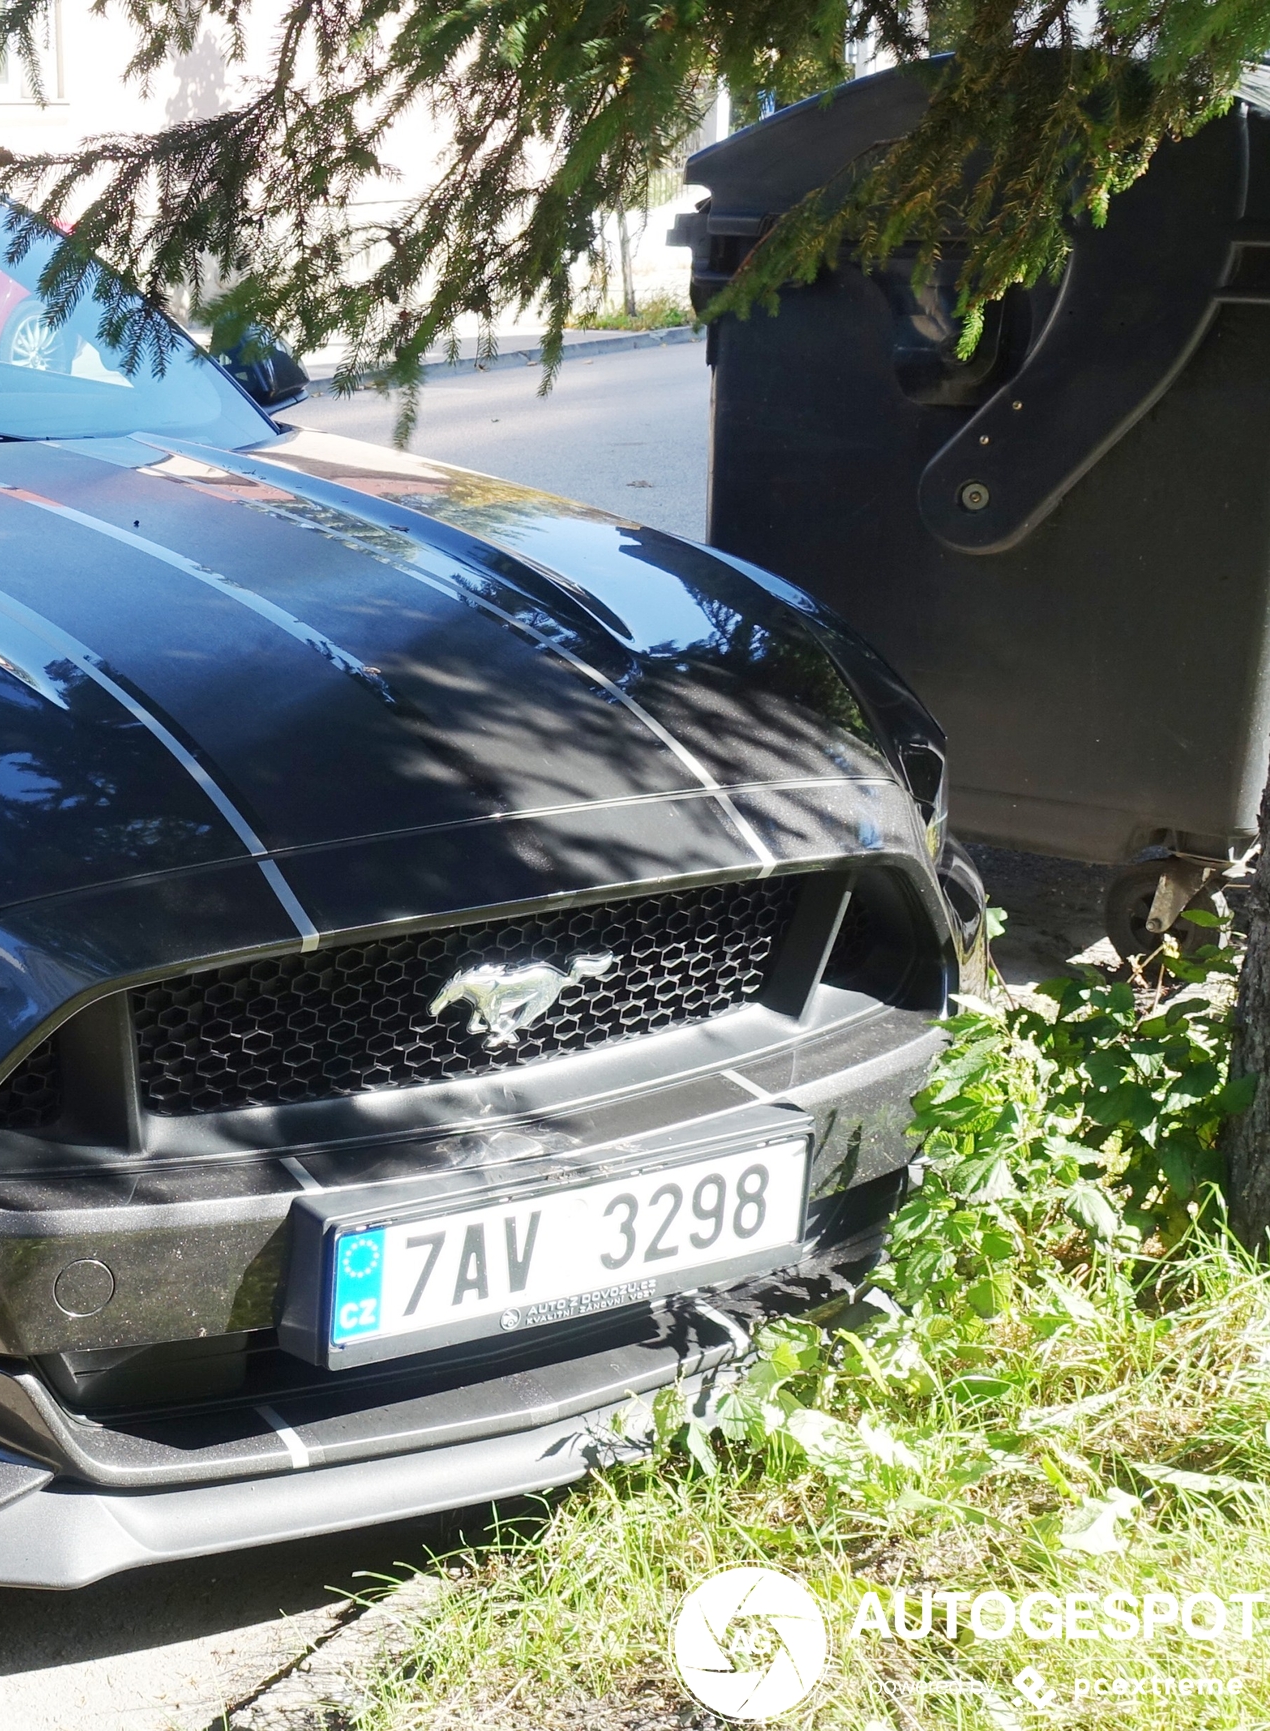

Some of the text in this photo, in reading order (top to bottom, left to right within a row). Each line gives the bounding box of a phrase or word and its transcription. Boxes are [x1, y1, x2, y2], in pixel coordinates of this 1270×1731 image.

[403, 1163, 770, 1316] 7AV 3298
[630, 1288, 656, 1300] VOZY
[339, 1298, 377, 1328] CZ
[527, 1299, 566, 1315] AUTO
